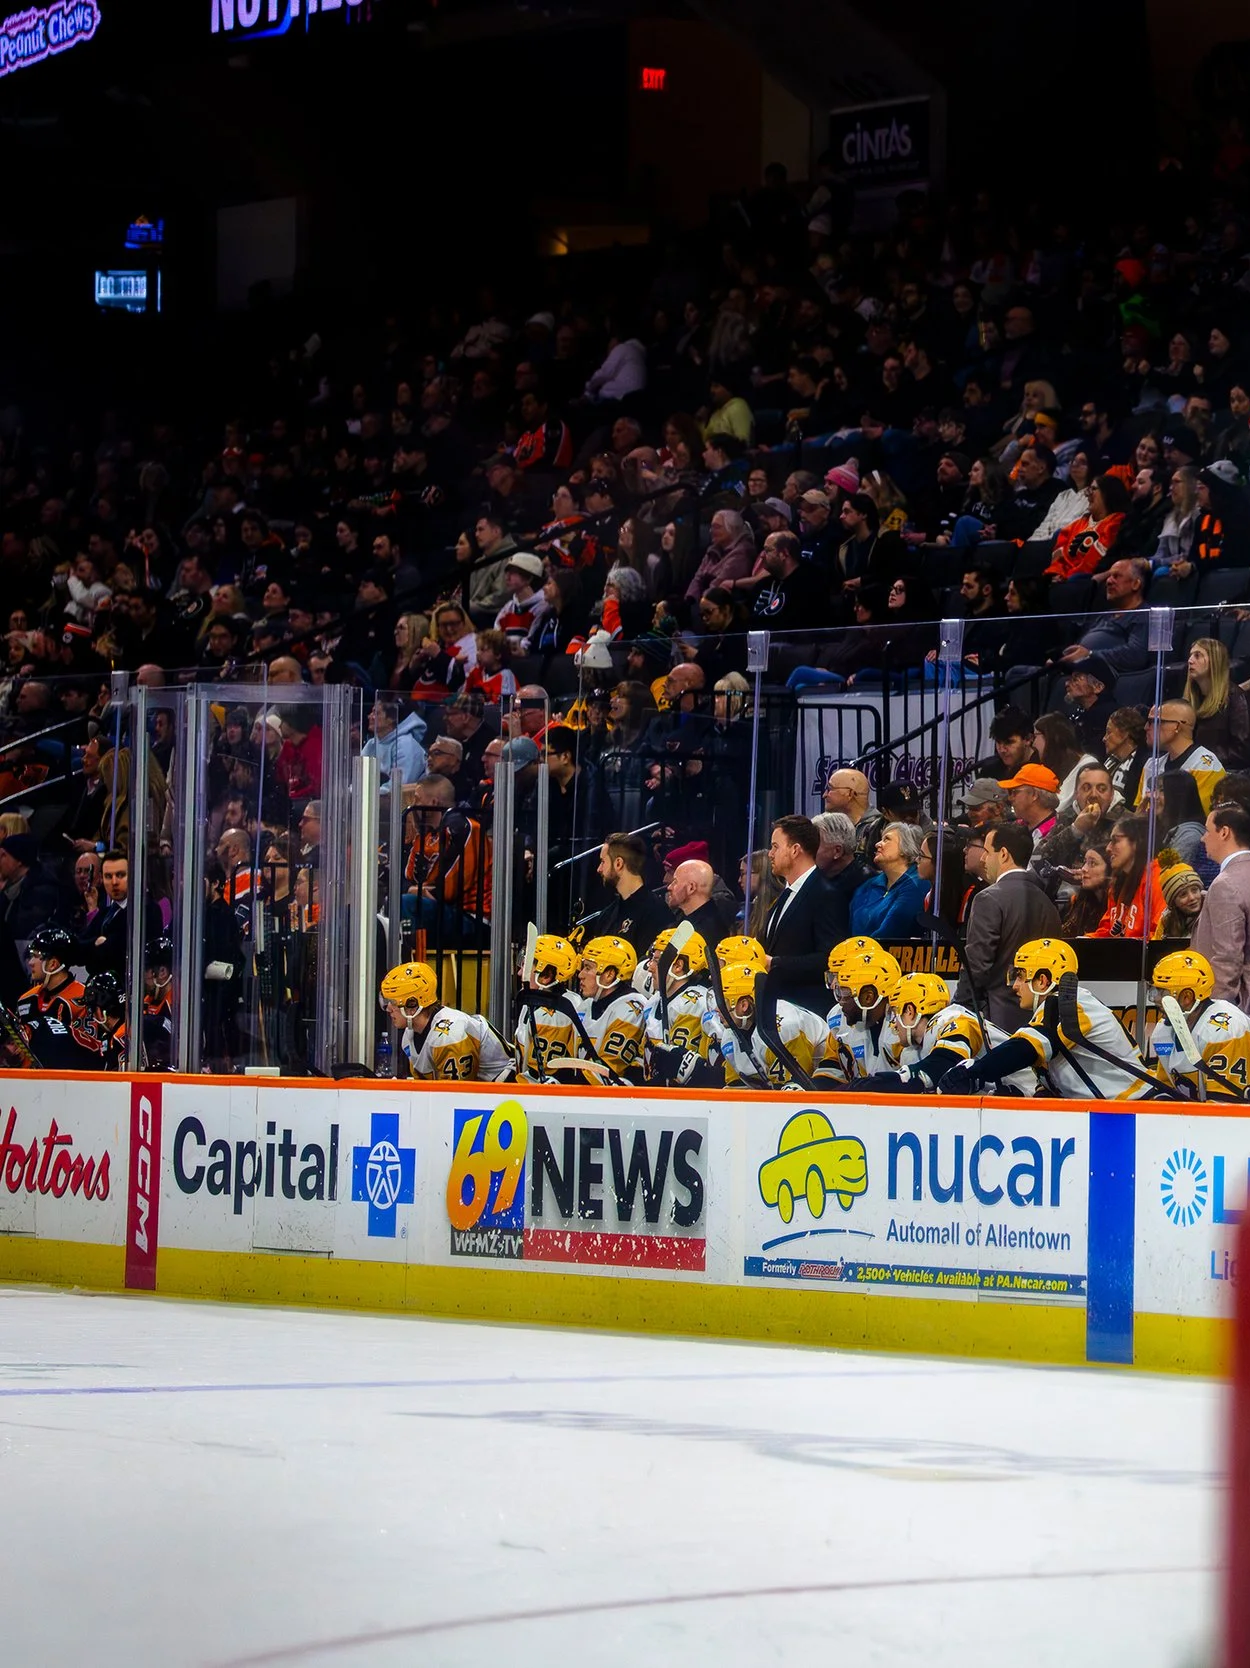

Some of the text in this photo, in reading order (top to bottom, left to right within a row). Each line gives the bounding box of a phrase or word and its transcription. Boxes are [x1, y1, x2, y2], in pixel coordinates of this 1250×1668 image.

[0, 17, 47, 67] Peanut
[48, 3, 93, 45] Chews
[889, 946, 961, 973] TRAILE
[604, 1031, 641, 1065] 26
[442, 1053, 475, 1082] 43
[1208, 1054, 1249, 1085] 24
[135, 1095, 153, 1255] CCM
[173, 1115, 340, 1216] Capital
[445, 1099, 705, 1231] 69 NEWS
[887, 1131, 1076, 1207] nucar
[886, 1218, 1071, 1251] Automall of Allentown
[762, 1261, 797, 1276] Formerly
[857, 1267, 892, 1282] 2,500+
[893, 1269, 934, 1284] Vehicles
[936, 1271, 981, 1286] Available
[983, 1275, 994, 1287] at
